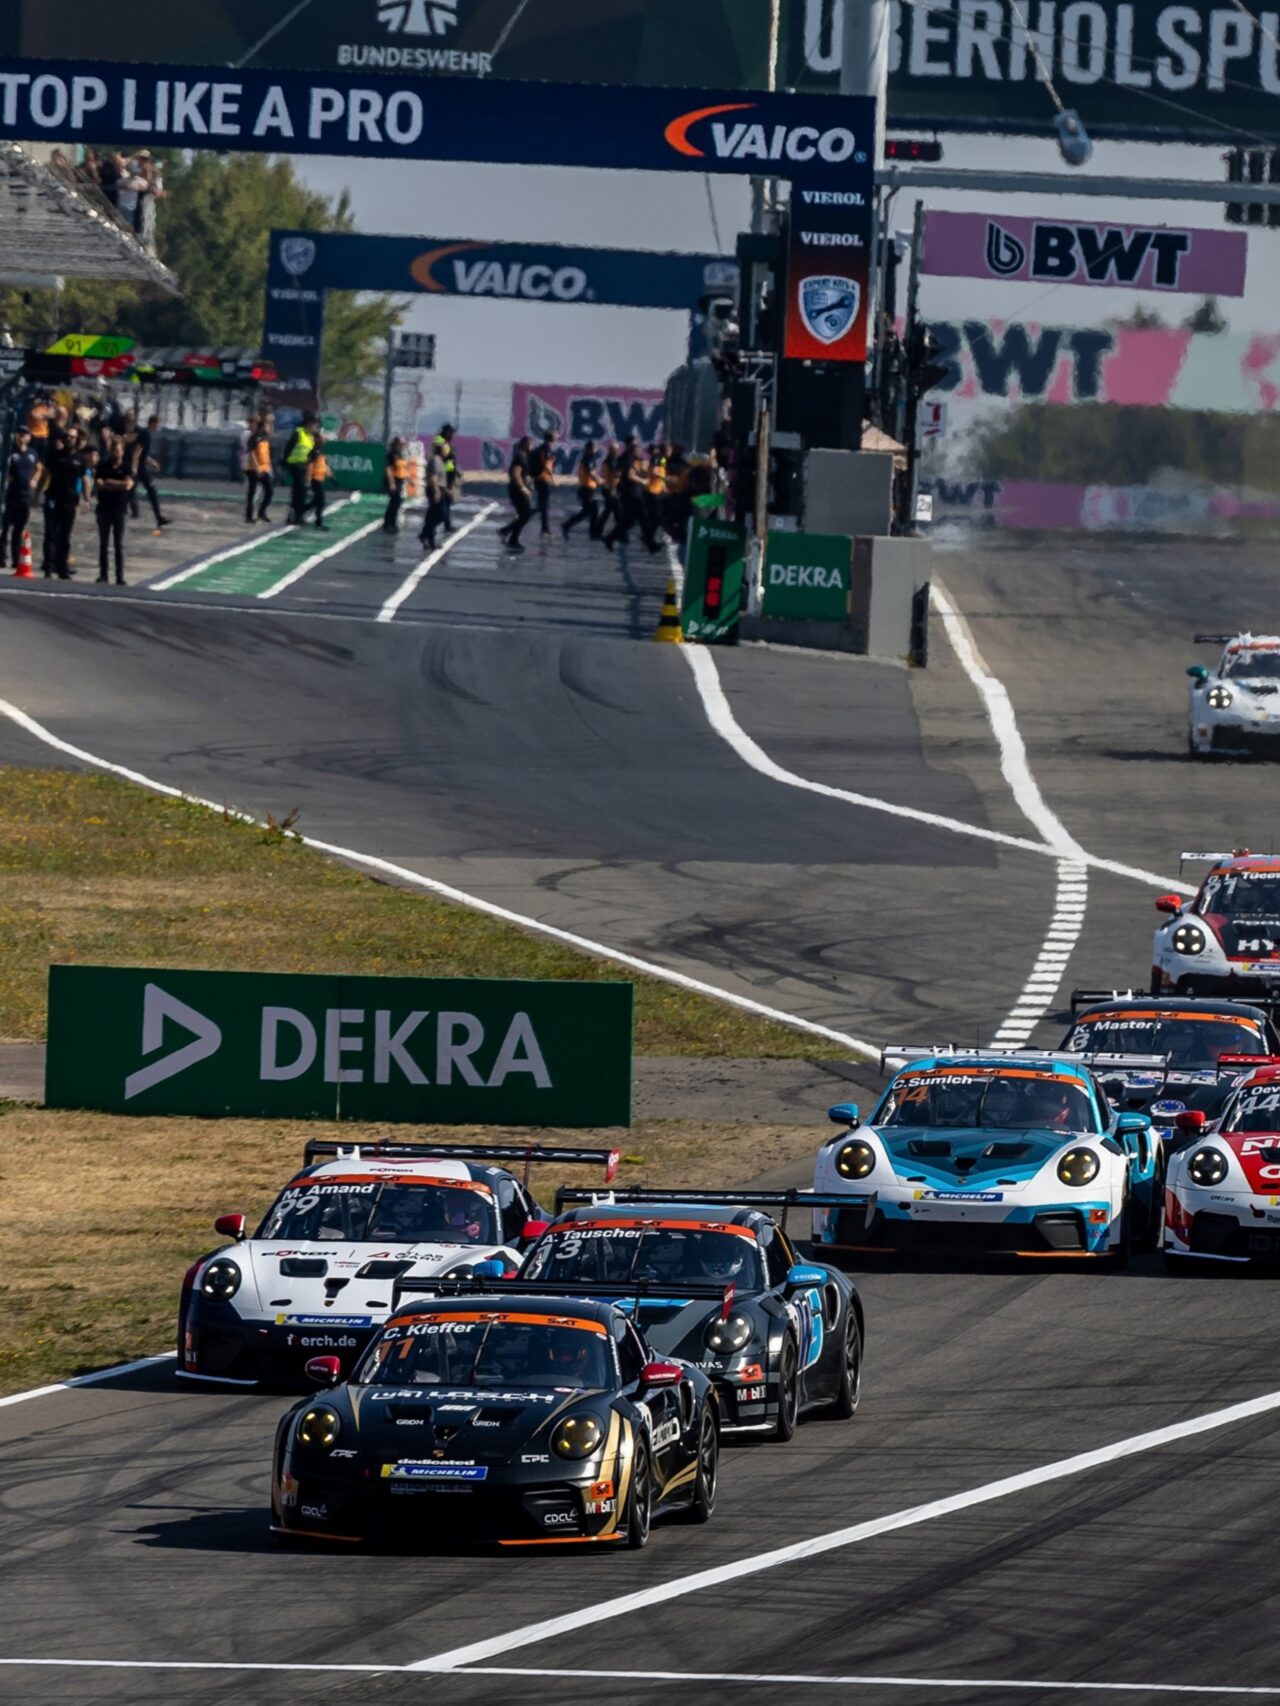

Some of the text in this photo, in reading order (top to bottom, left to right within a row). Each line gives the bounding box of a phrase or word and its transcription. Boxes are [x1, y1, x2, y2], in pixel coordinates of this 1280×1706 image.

[337, 44, 492, 74] BUNDESWEHR
[122, 78, 243, 135] LIKE
[253, 86, 294, 137] A
[308, 87, 423, 145] PRO
[711, 123, 855, 162] VAICO
[802, 190, 865, 206] VIEROL
[801, 231, 863, 247] VIEROL
[1033, 225, 1190, 287] BWT
[453, 259, 588, 300] VAICO
[571, 399, 665, 443] BW
[769, 563, 844, 590] DEKRA
[1074, 1025, 1090, 1034] K.
[260, 1005, 553, 1088] DEKRA
[282, 1183, 376, 1200] M. Amand
[938, 1193, 997, 1202] MICHELIN
[301, 1317, 365, 1326] MICHELIN
[384, 1323, 475, 1340] C. Kieffer
[397, 1458, 475, 1466] dedicated
[411, 1469, 478, 1477] MICHELIN
